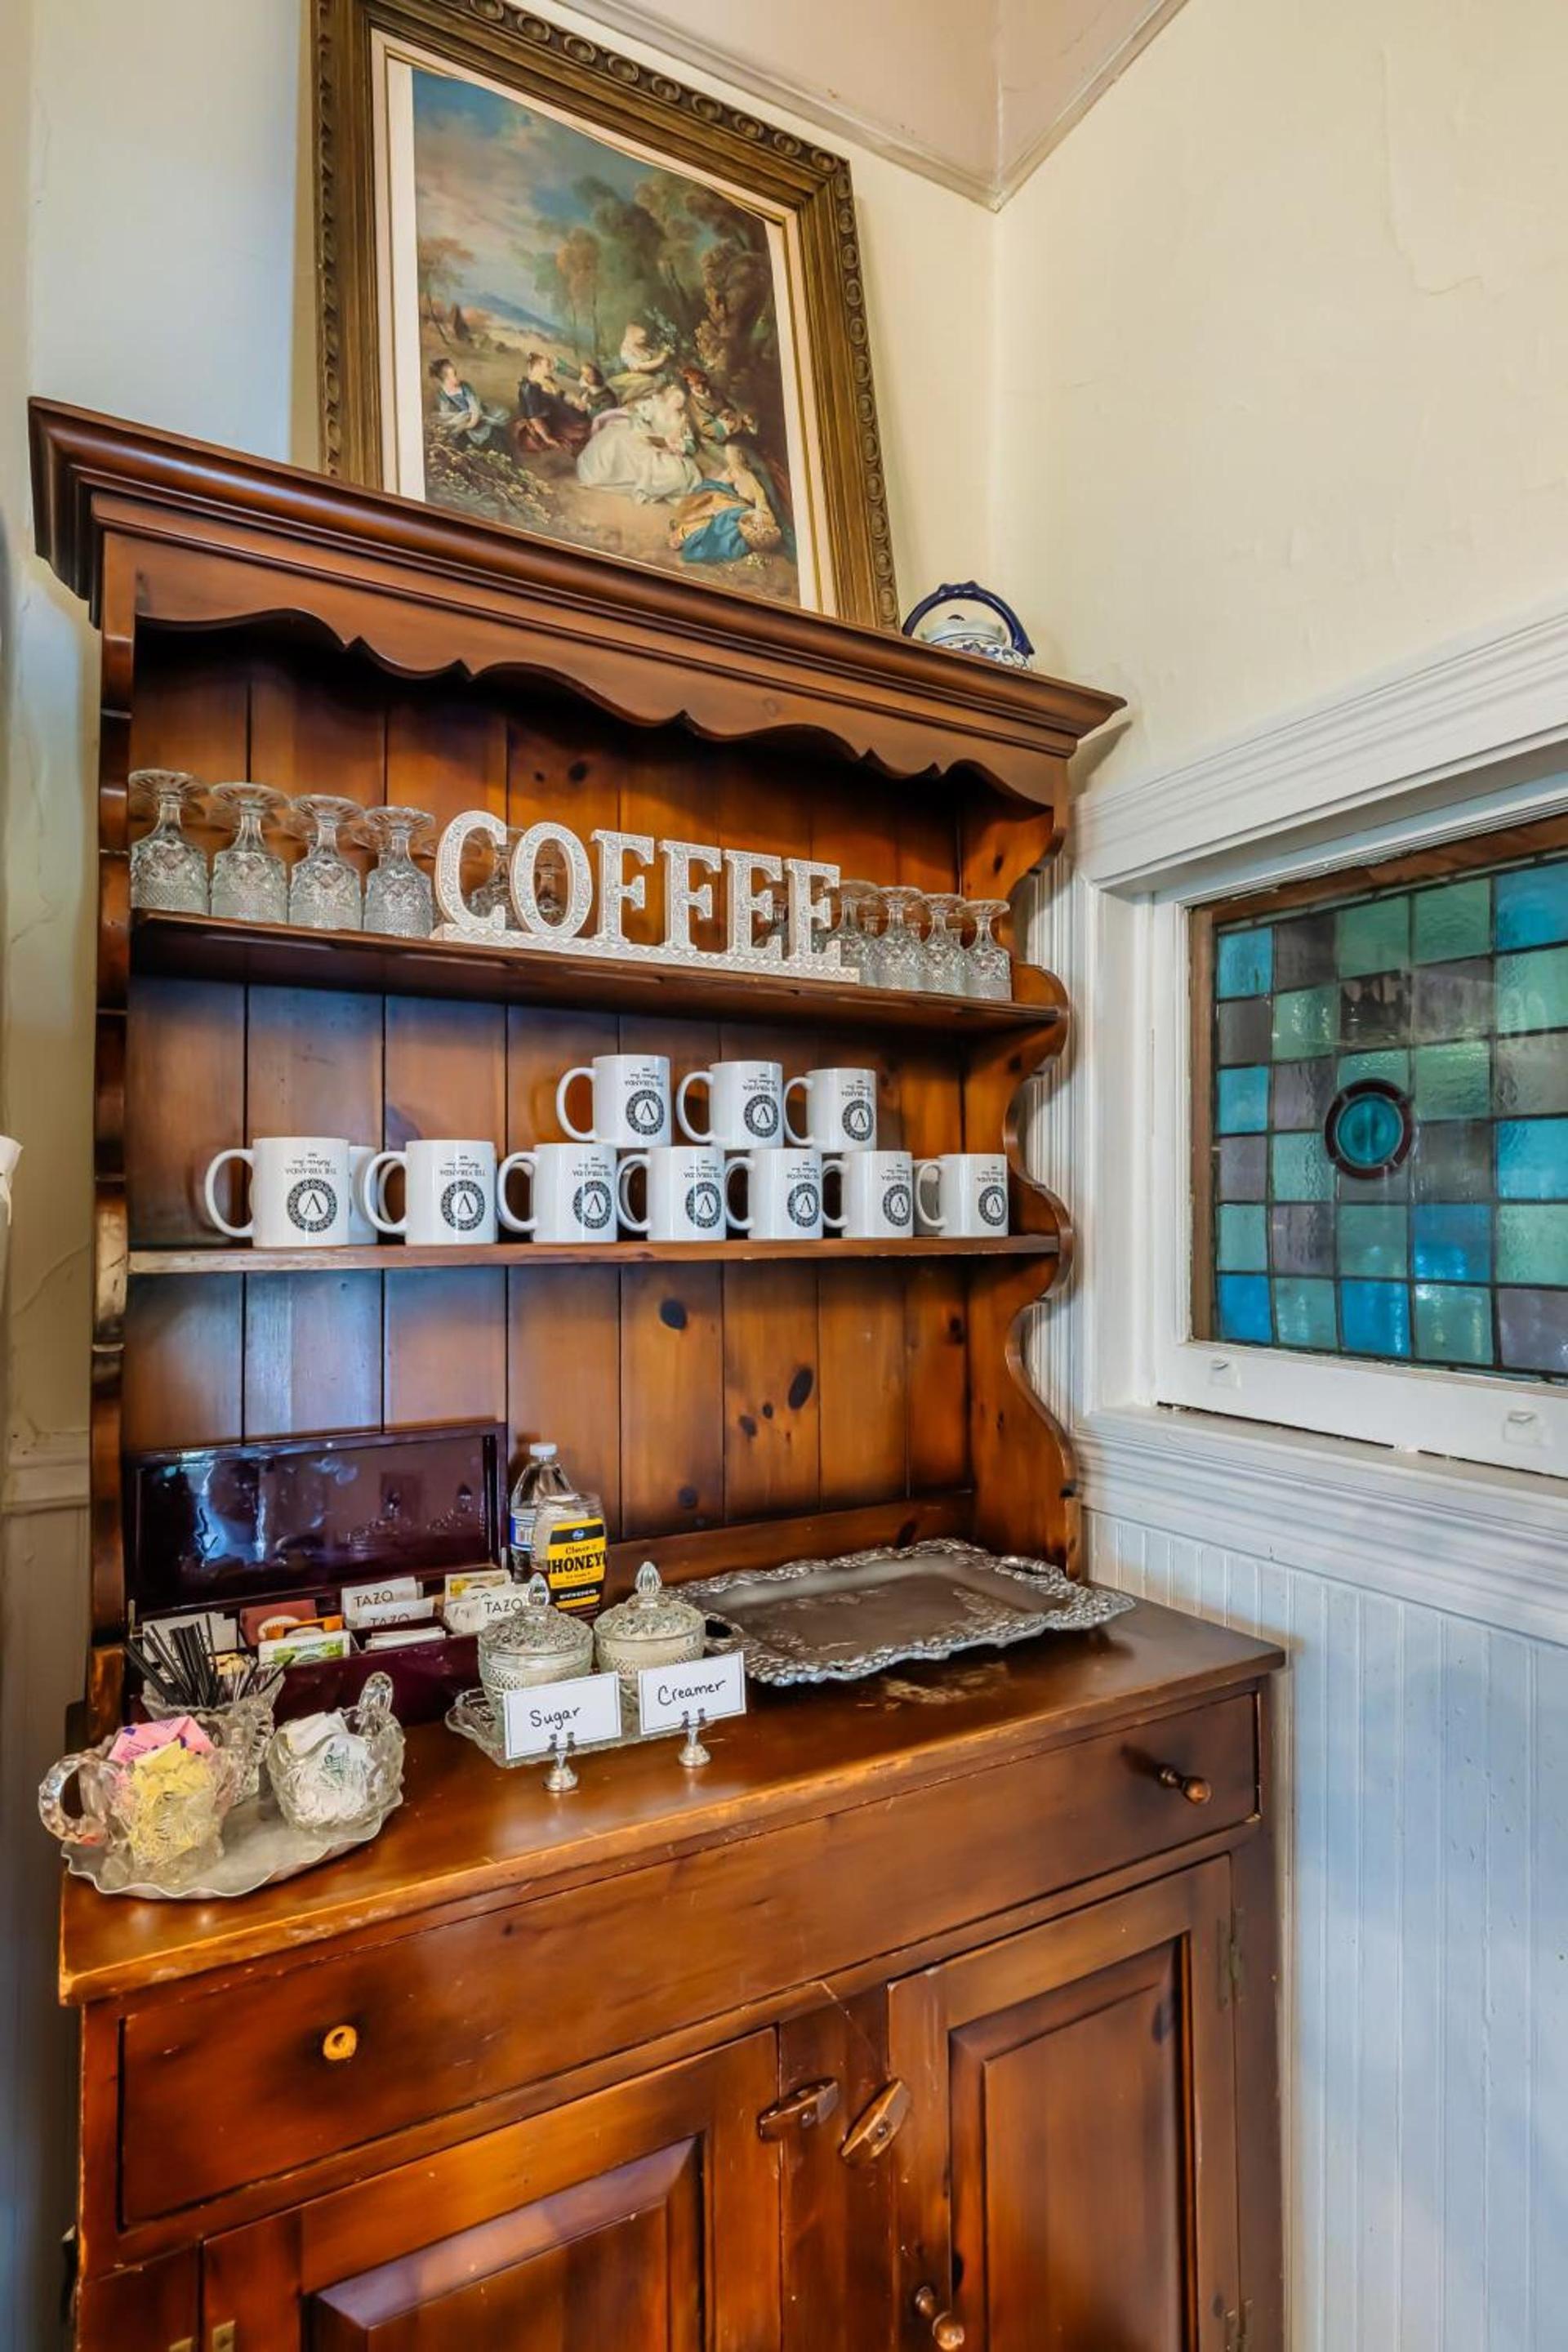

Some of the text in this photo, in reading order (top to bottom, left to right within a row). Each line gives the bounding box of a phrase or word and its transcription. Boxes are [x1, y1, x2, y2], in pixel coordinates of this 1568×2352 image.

[436, 810, 841, 967] COFFEE
[551, 1551, 603, 1574] HONEY
[353, 1590, 394, 1607] TAZO
[483, 1598, 523, 1614] TAZO
[657, 1679, 727, 1706] Creamer
[529, 1705, 582, 1730] Sugar
